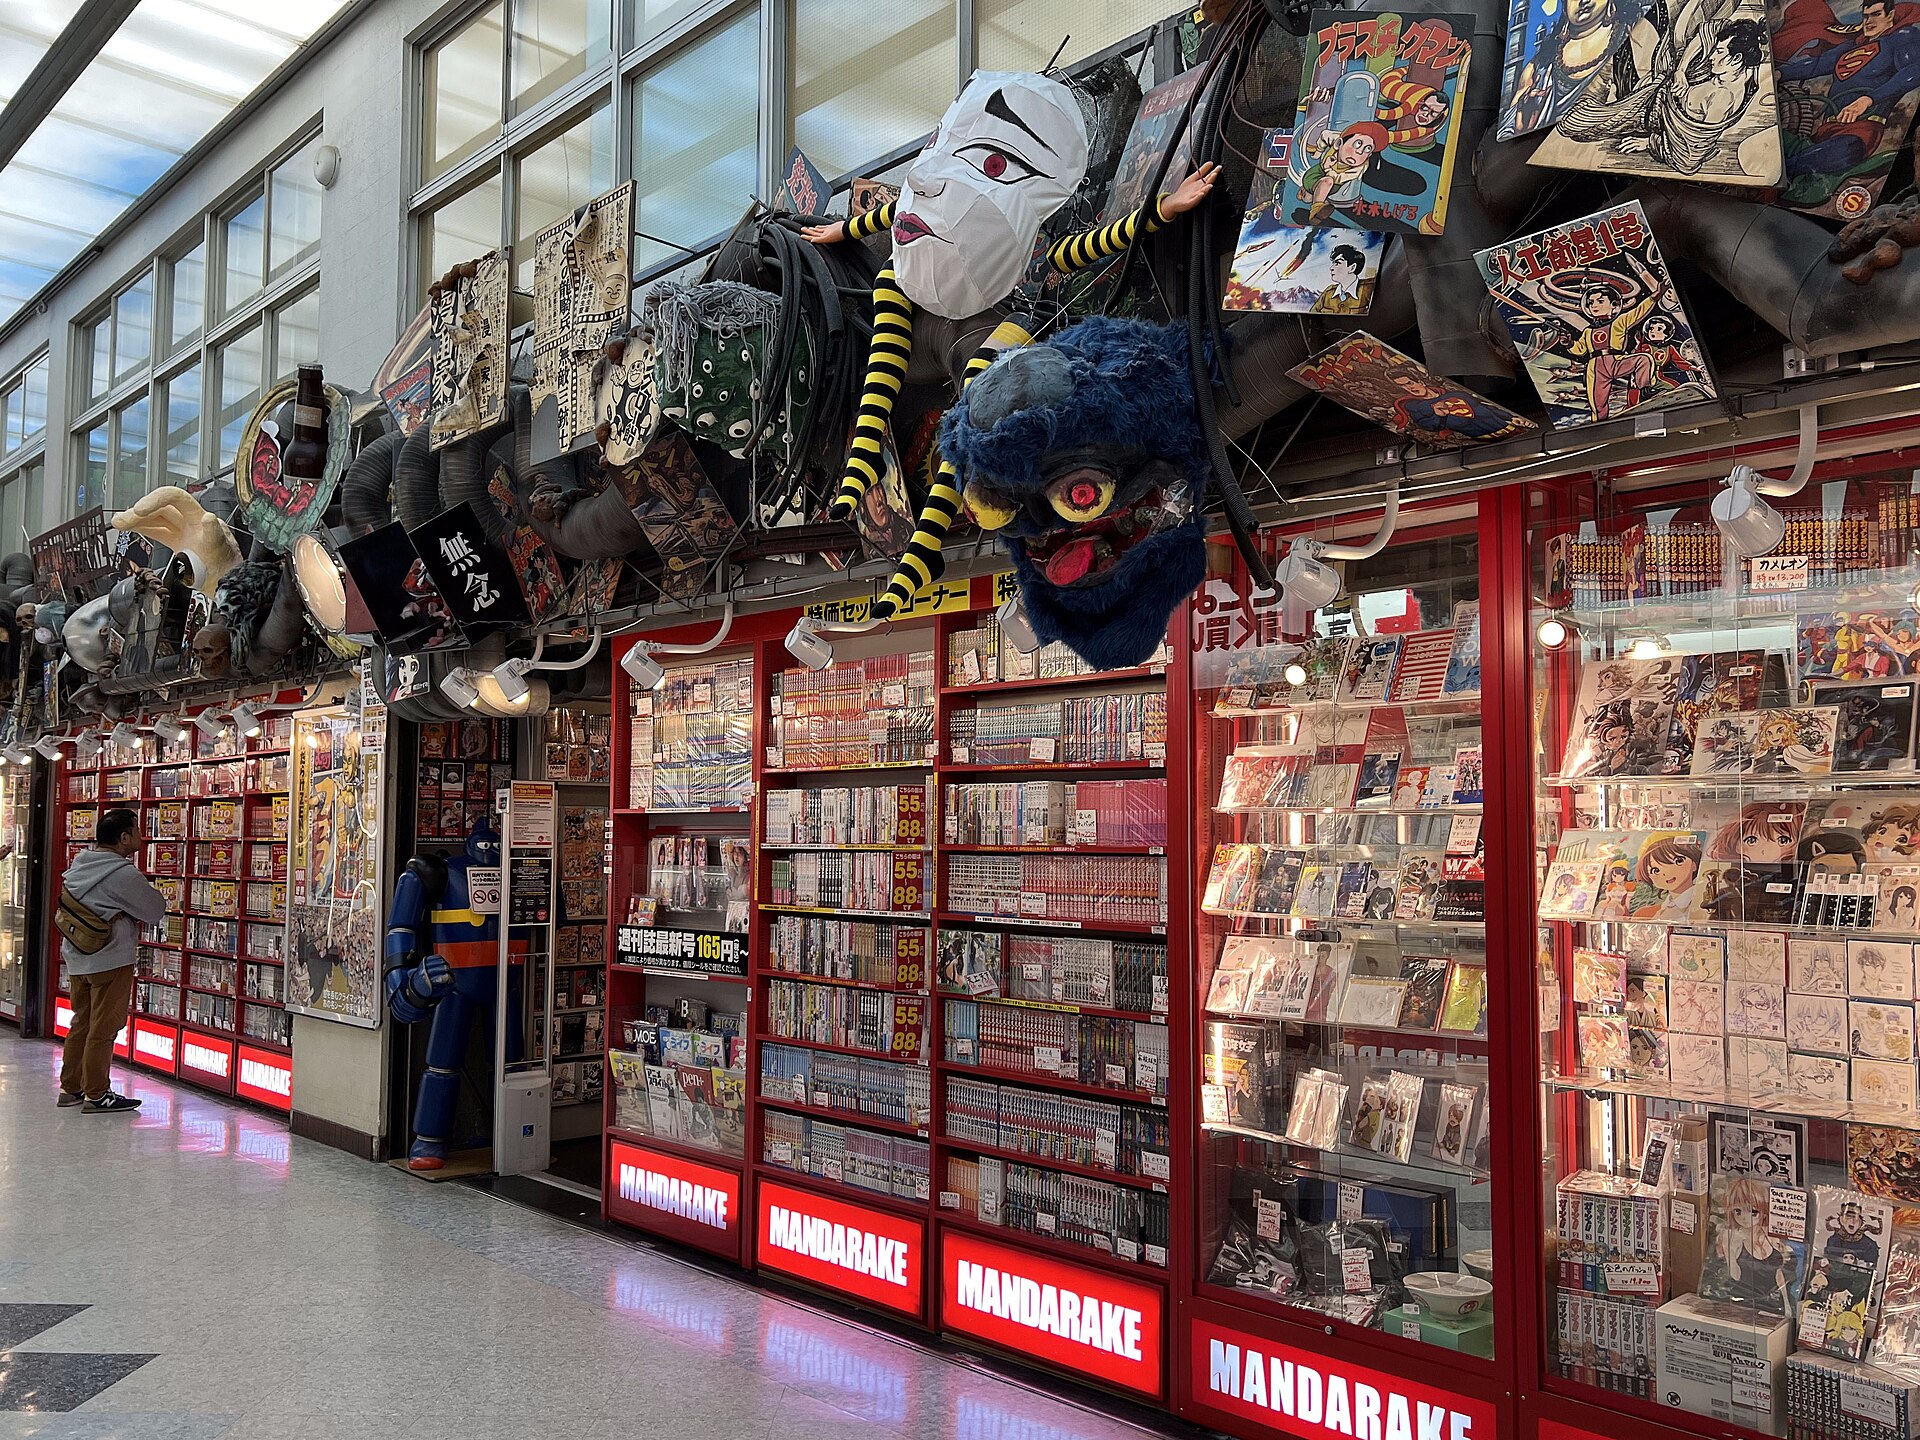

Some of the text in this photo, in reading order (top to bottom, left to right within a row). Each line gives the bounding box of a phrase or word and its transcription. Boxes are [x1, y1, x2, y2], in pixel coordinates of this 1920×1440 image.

[1318, 20, 1472, 69] プラスチックマン
[1498, 212, 1647, 290] 人工衛星1号
[439, 531, 501, 613] 無念
[1759, 559, 1808, 571] カメレオン
[633, 1029, 657, 1045] MOE
[240, 1058, 291, 1097] MANDARAKE
[619, 1164, 728, 1231] MANDARAKE
[769, 1206, 908, 1287] MANDARAKE
[957, 1260, 1142, 1362] MANDARAKE
[1210, 1338, 1472, 1440] MANDARAKE
